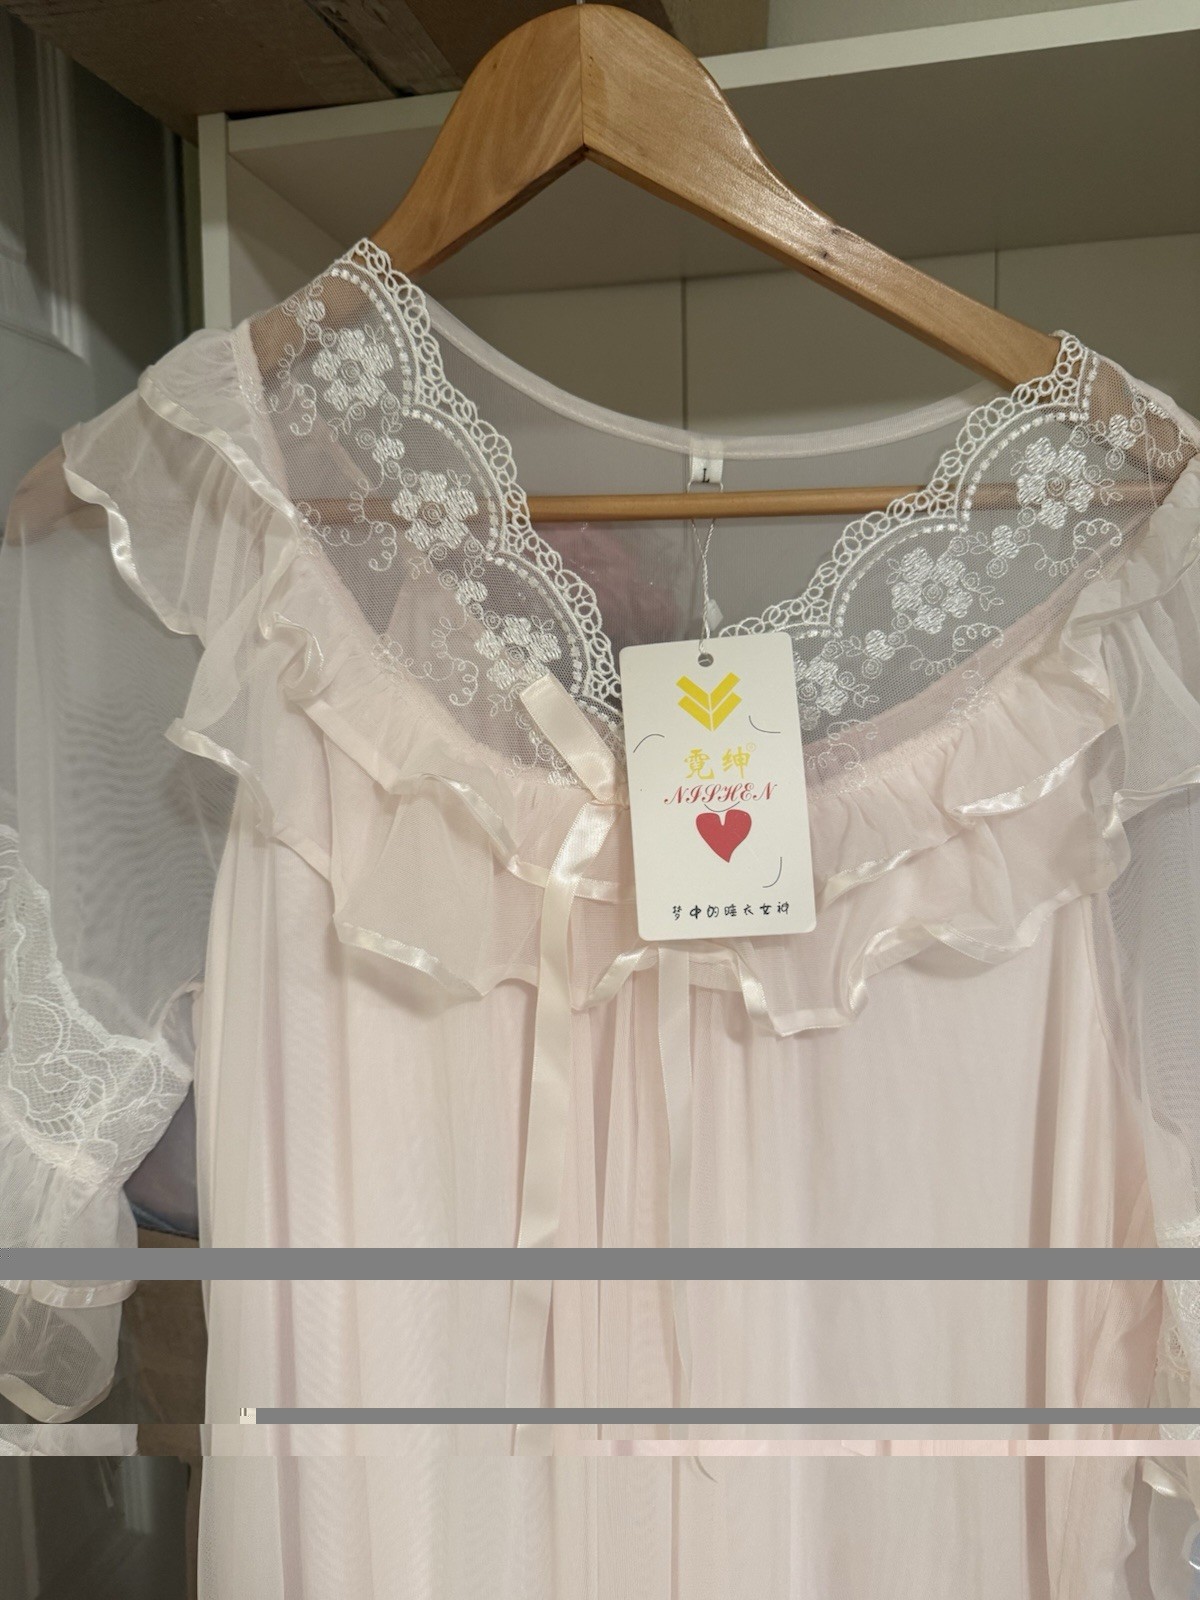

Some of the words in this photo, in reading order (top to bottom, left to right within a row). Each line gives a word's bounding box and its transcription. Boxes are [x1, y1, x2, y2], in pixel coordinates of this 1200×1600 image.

[702, 468, 710, 483] L
[664, 781, 778, 805] NISHEN
[672, 901, 790, 921] 梦中的睡衣女神
